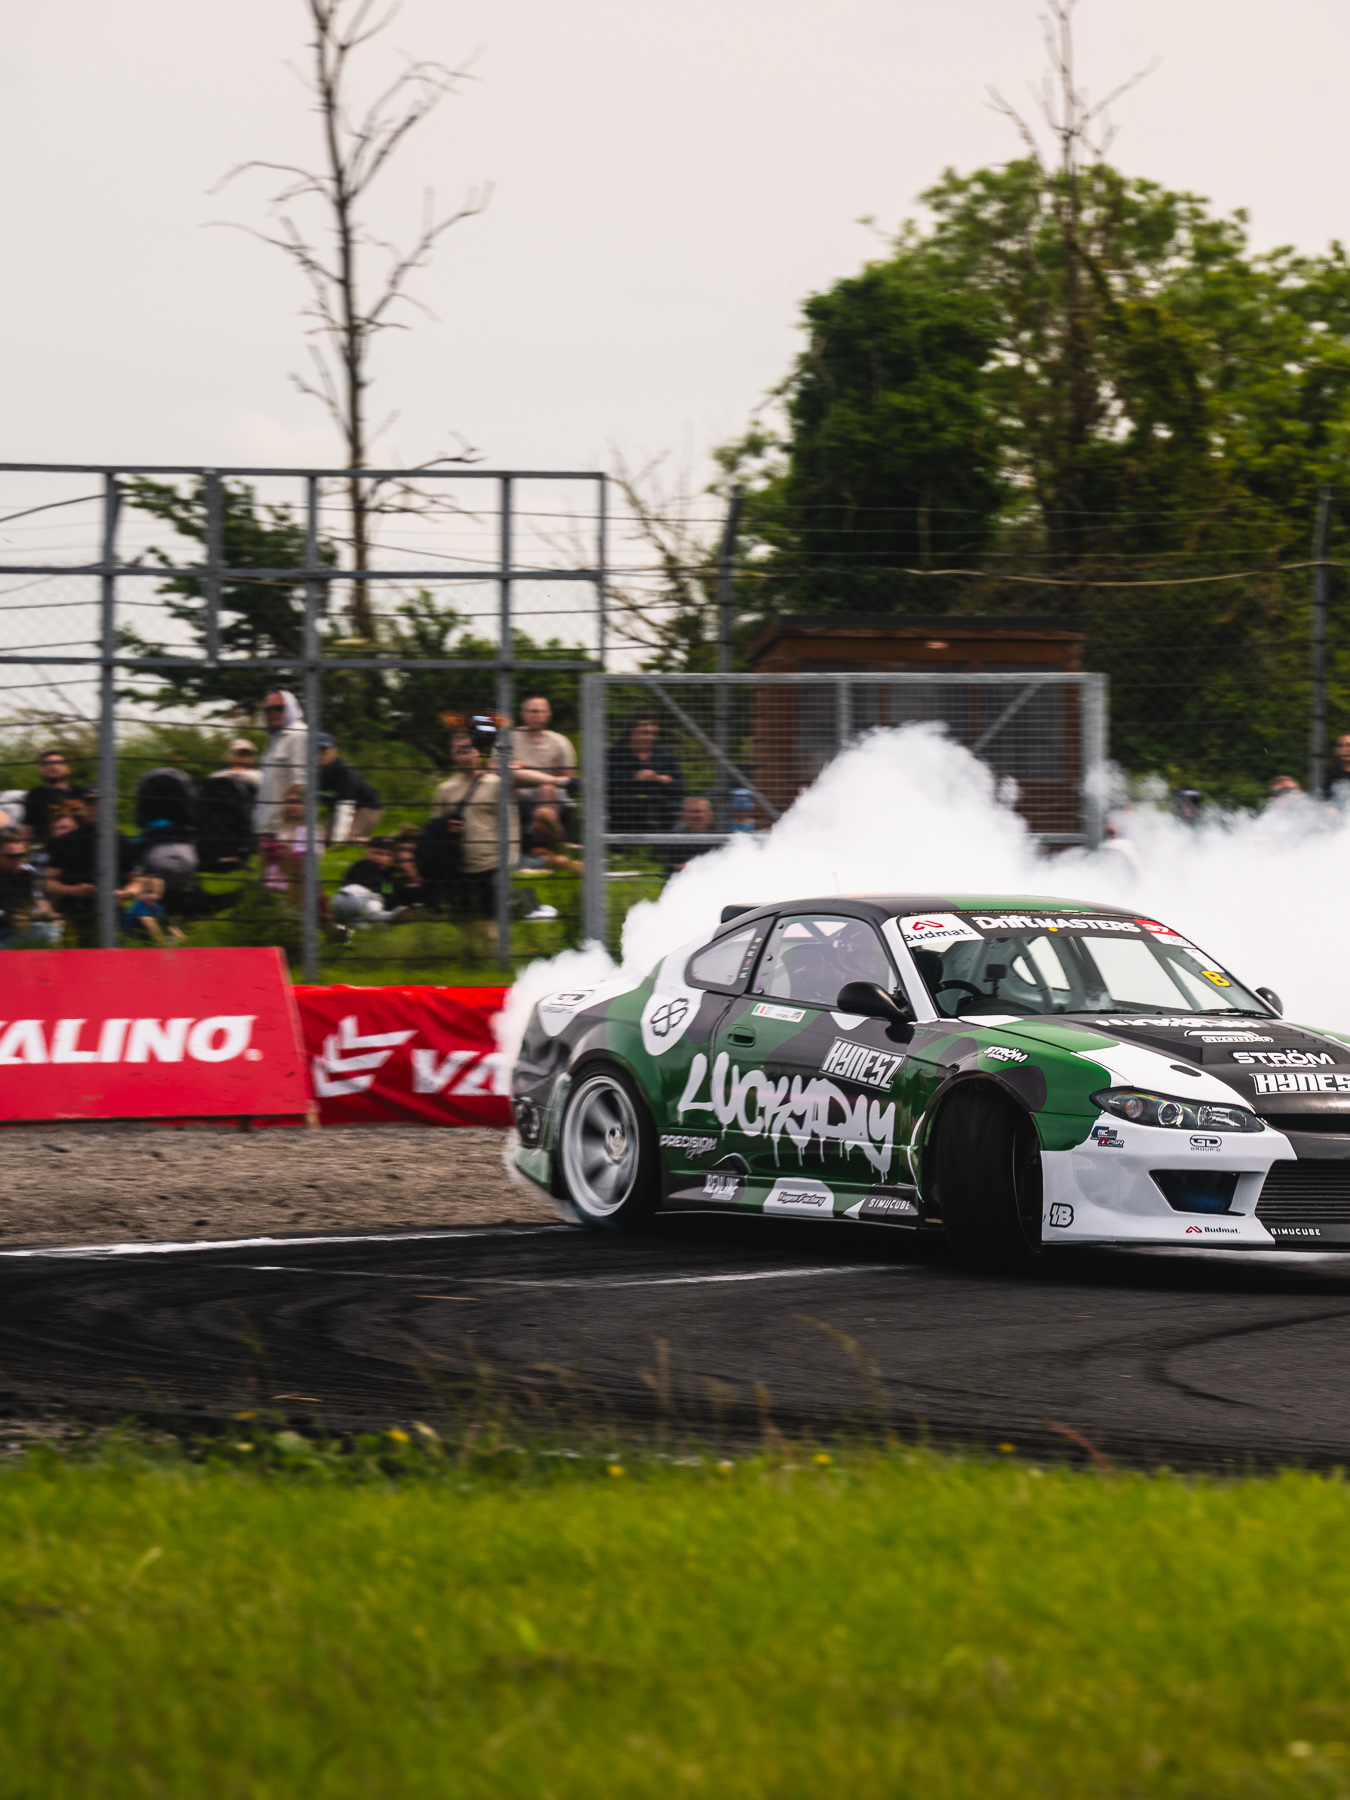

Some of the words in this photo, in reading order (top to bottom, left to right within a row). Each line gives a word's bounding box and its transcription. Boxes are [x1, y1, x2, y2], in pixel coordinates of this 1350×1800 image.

[0, 1014, 259, 1065] ALINO
[821, 1039, 904, 1089] HYNESZ
[1232, 1049, 1336, 1065] STRÖM
[868, 1198, 911, 1211] SIMUCUBE
[1270, 1227, 1322, 1237] SIMUCUBE
